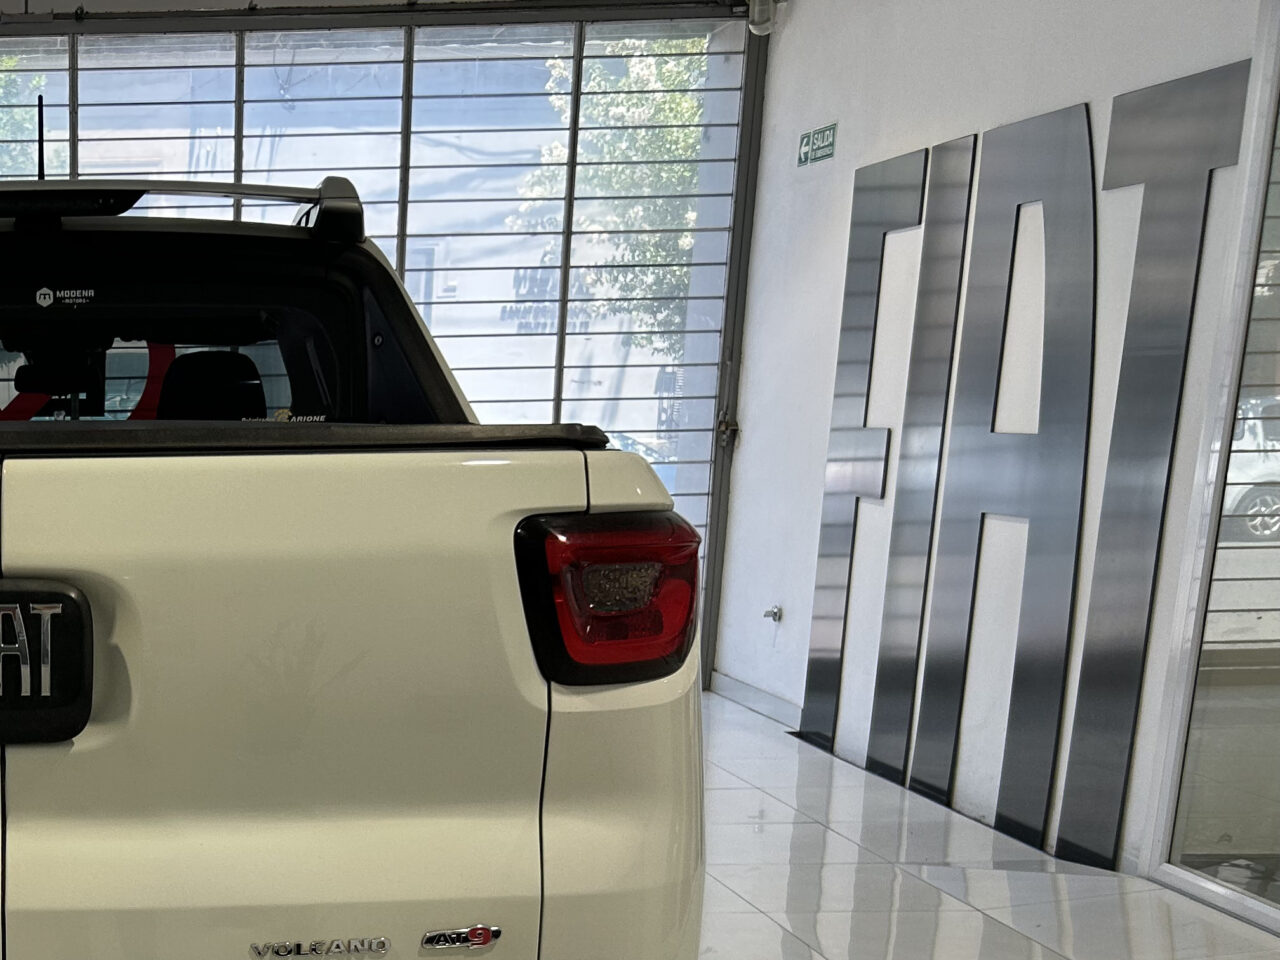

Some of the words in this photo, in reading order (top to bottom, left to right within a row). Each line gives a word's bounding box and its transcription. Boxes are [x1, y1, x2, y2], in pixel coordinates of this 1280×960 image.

[56, 289, 95, 298] MODENA
[290, 415, 327, 423] ARIONE
[800, 58, 1252, 871] FIAT
[250, 936, 392, 960] VOLCANO
[432, 925, 494, 950] AT9
